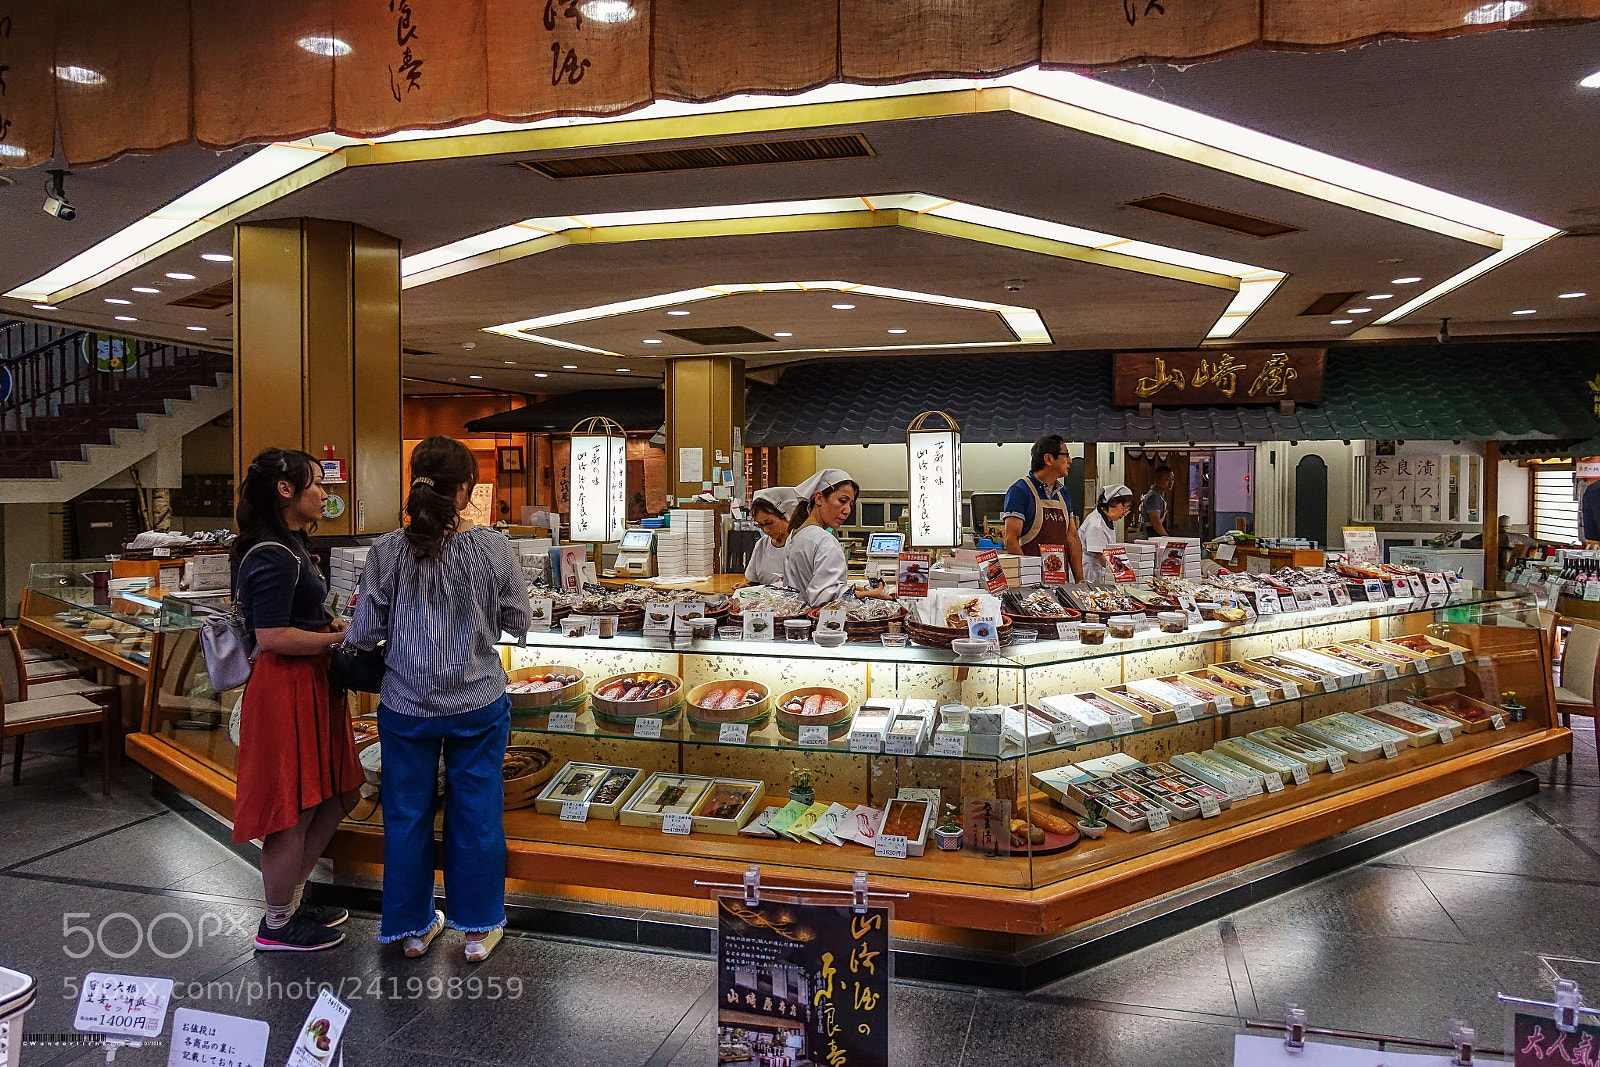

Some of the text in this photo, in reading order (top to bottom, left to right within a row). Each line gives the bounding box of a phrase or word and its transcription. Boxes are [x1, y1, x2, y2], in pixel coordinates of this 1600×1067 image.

[1374, 459, 1436, 477] 奈良漬
[1373, 486, 1433, 500] アイス
[98, 1014, 146, 1029] 1400円
[182, 1022, 216, 1037] お値段は
[184, 1036, 237, 1055] 各商品の裏に
